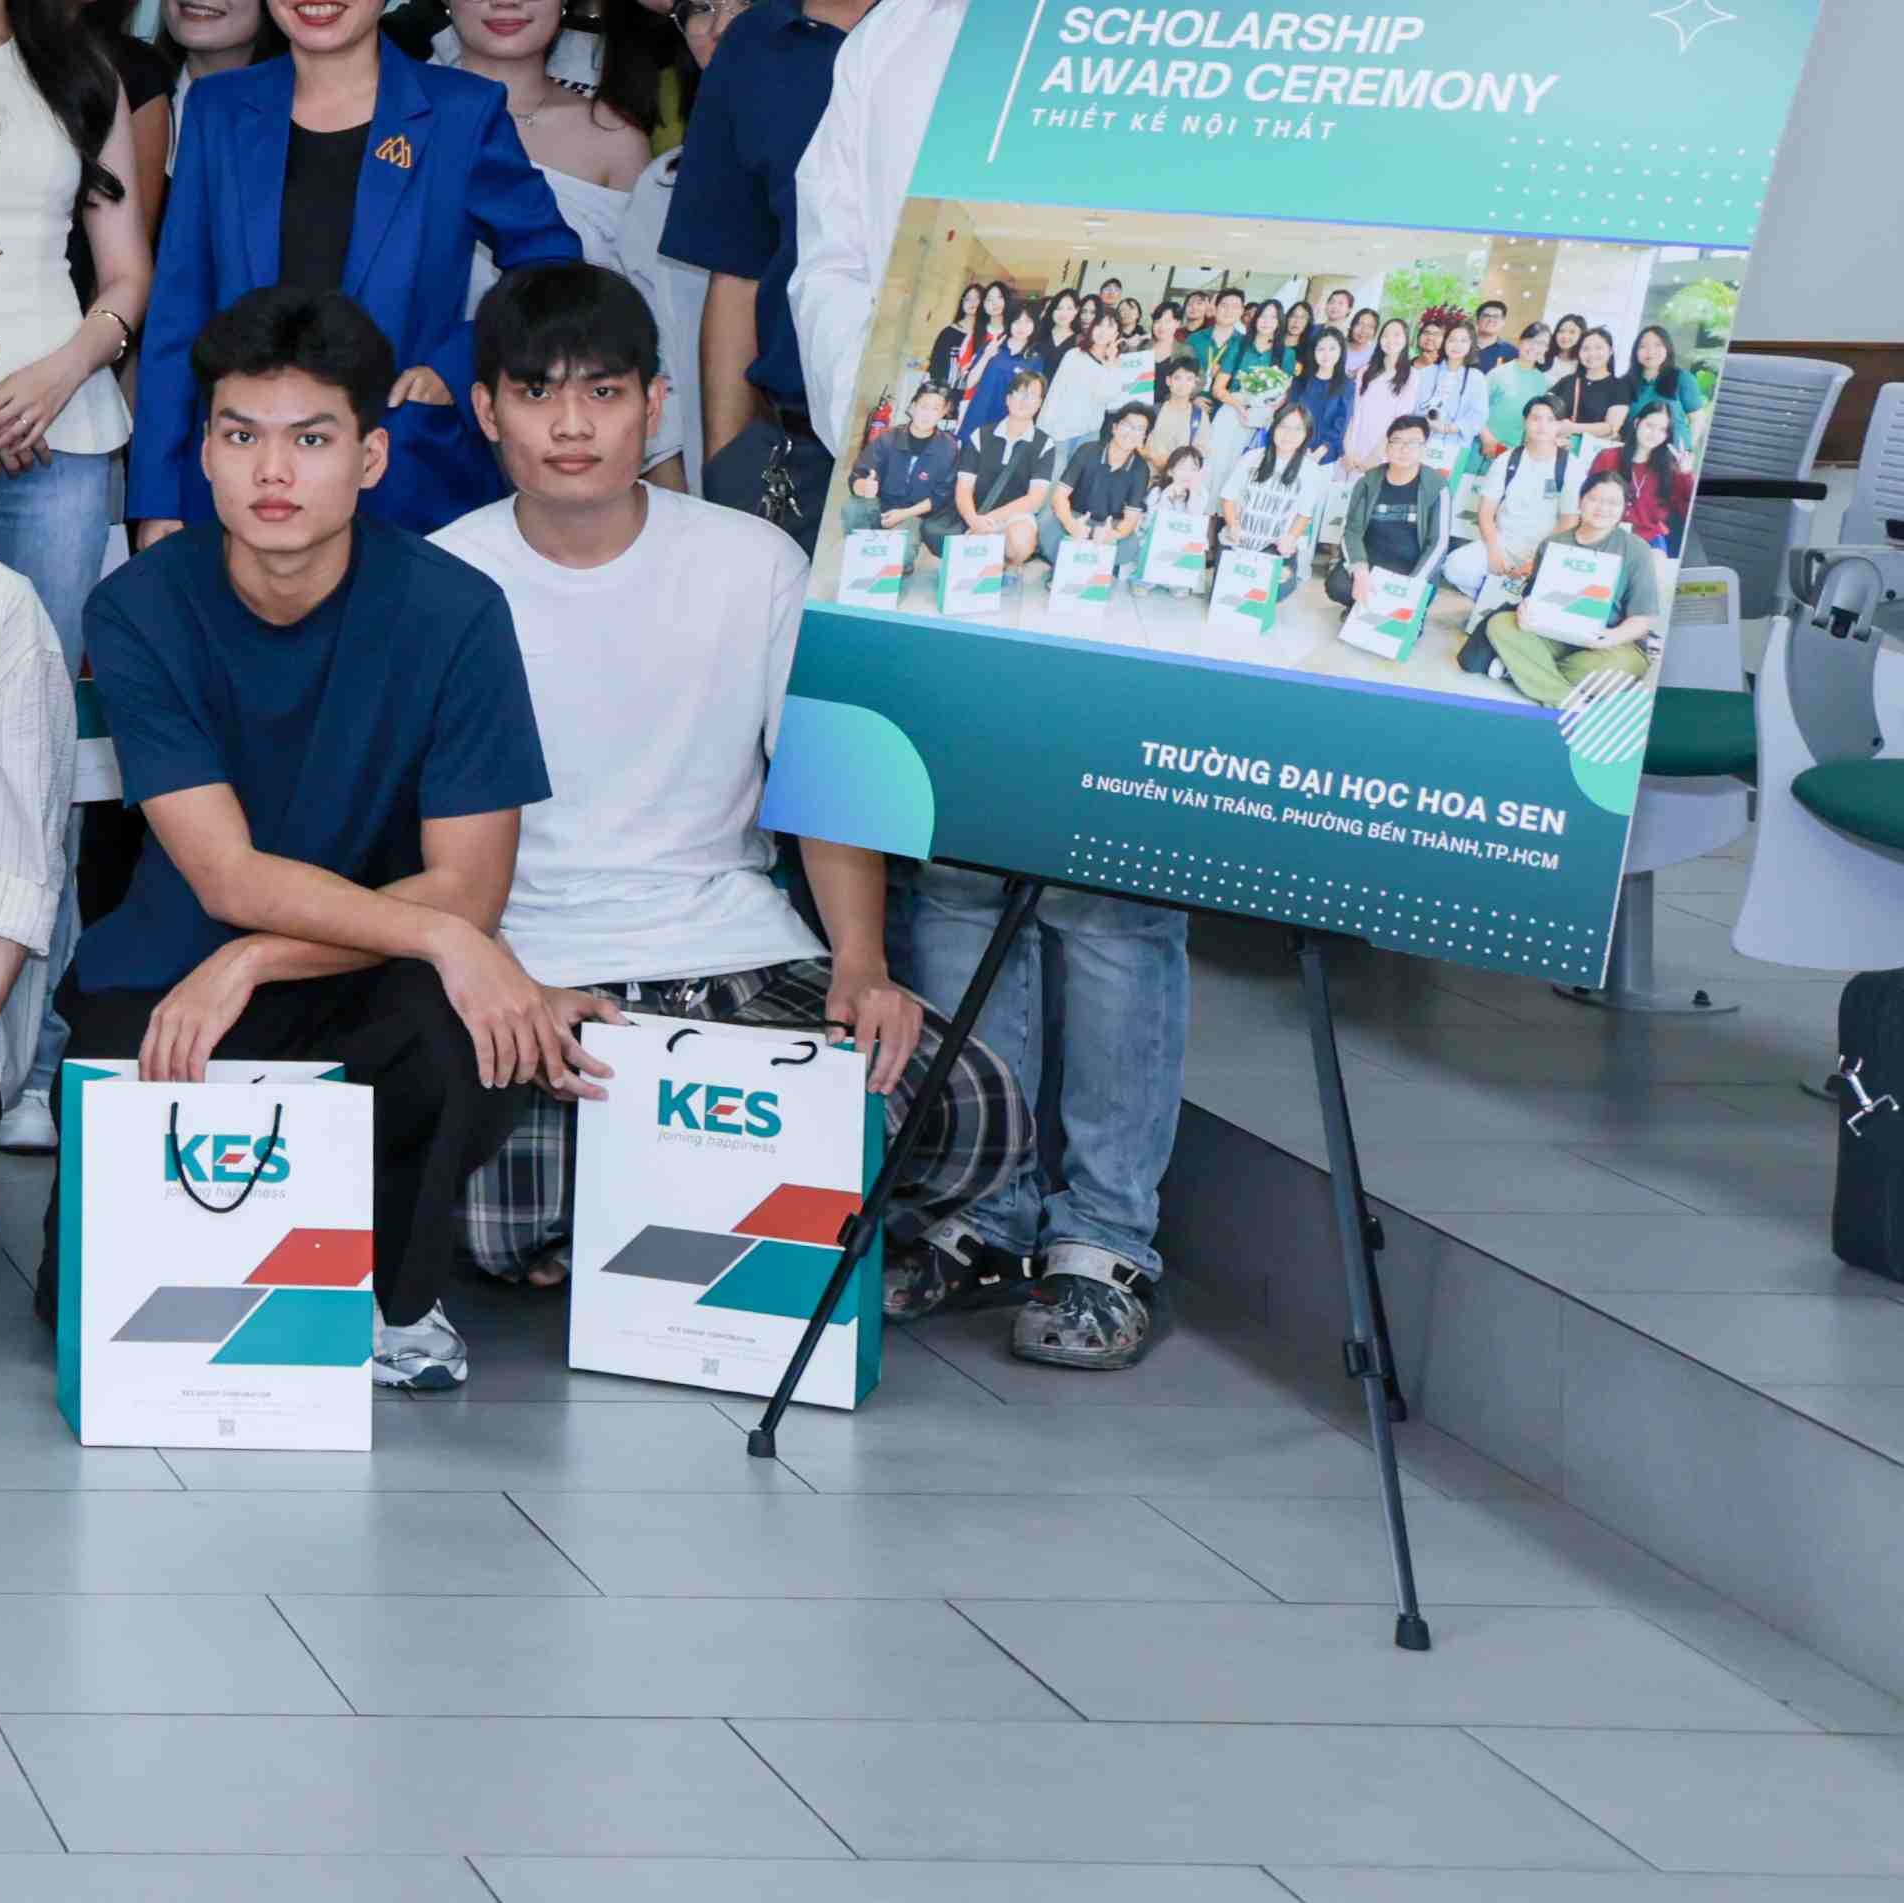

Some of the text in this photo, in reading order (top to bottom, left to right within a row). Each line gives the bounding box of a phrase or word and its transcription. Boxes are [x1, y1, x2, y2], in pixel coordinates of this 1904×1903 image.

[1058, 7, 1425, 55] SCHOLARSHIP
[1040, 56, 1560, 114] AWARD CEREMONY
[1031, 101, 1338, 141] THIẾT KẾ NỘI THẤT
[1562, 558, 1597, 574] KES
[1081, 773, 1093, 789] 8
[1096, 774, 1168, 803] NGUYỄN
[1172, 783, 1208, 809] VĂN
[1212, 792, 1278, 823] TRÁNG,
[1282, 806, 1363, 837] PHƯỜNG
[1368, 818, 1406, 844] BẾN
[1141, 740, 1567, 836] TRƯỜNG ĐẠI HỌC HOA SEN
[657, 1079, 782, 1138] KES
[164, 1133, 291, 1184] KES
[657, 1129, 777, 1155] joining happiness
